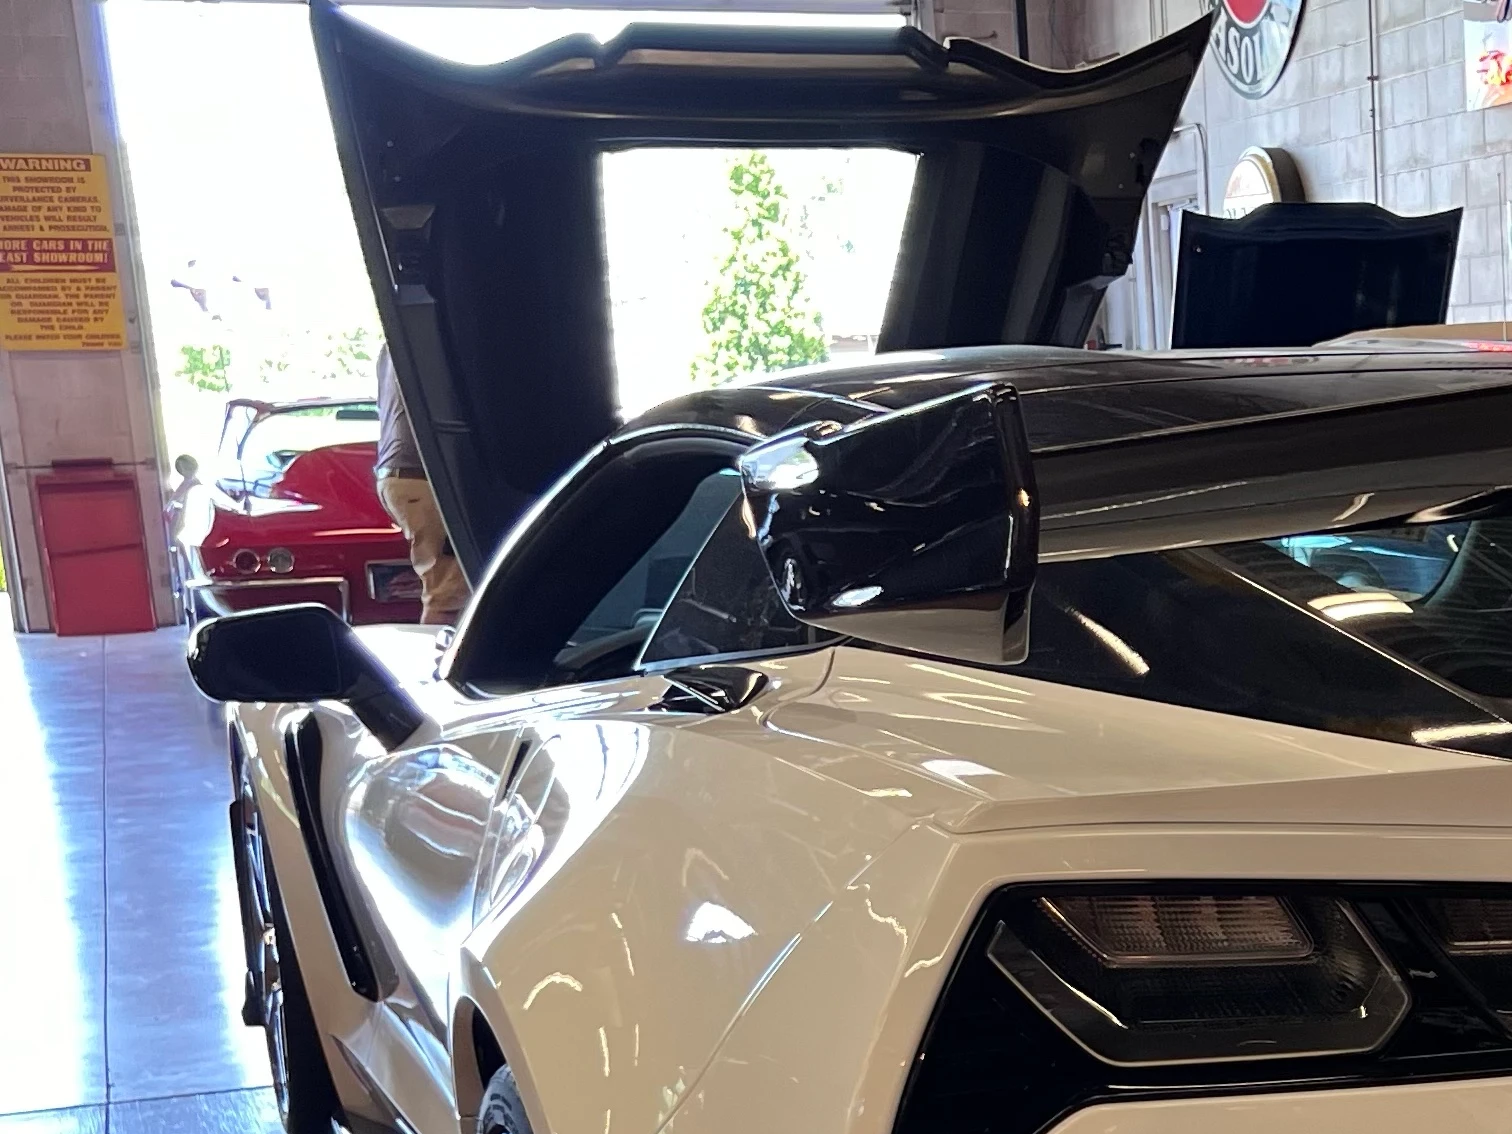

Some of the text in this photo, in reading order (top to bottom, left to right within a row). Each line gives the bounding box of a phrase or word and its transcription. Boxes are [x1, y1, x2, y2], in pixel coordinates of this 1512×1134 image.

[0, 158, 86, 170] WARNING
[24, 176, 74, 184] SHOWROOM
[0, 205, 28, 213] AMAGE
[32, 239, 66, 250] CARS
[69, 240, 83, 250] IN
[87, 240, 108, 250] THE
[33, 252, 109, 264] SHOWROOM!
